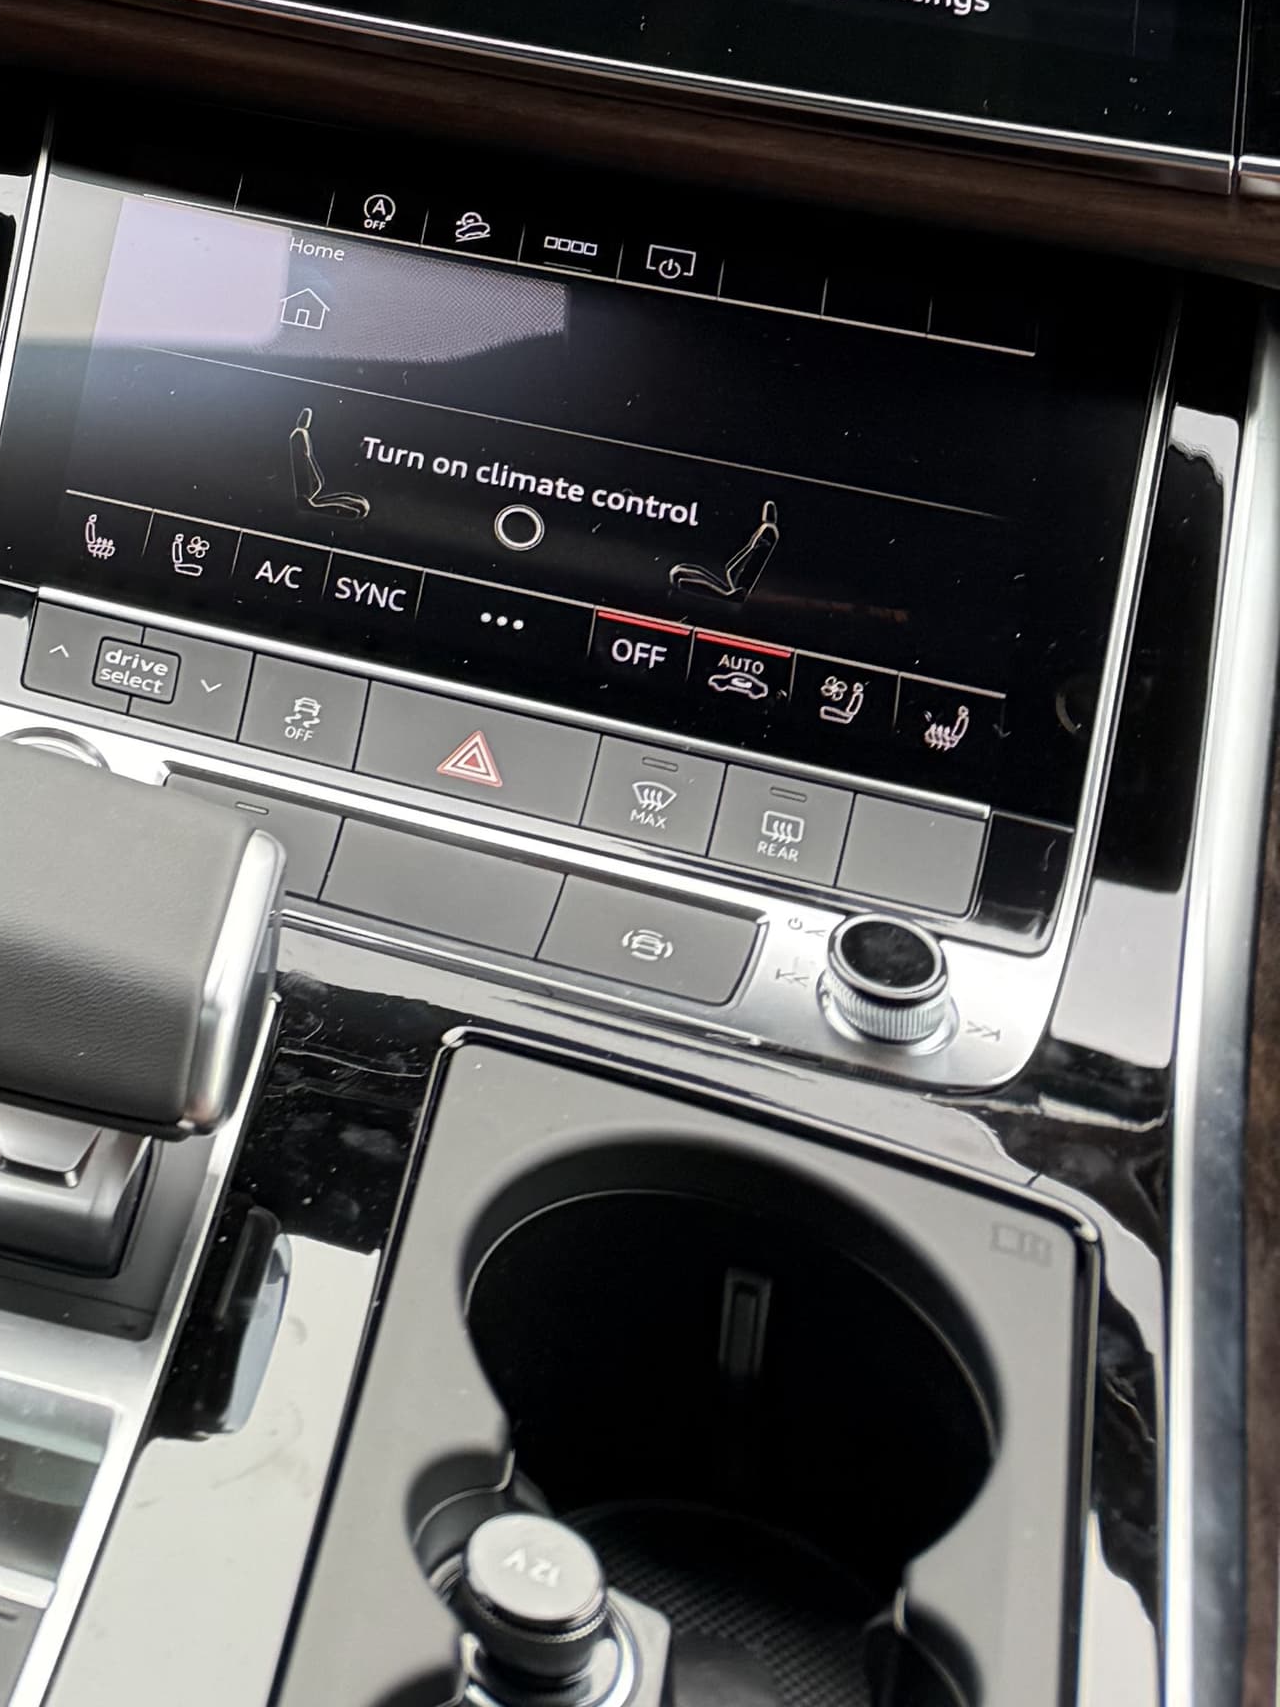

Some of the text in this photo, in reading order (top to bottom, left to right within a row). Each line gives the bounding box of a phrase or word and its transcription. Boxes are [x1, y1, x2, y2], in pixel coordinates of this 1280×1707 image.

[364, 218, 386, 231] OFF
[289, 237, 345, 262] Home
[363, 436, 699, 526] Turn on climate control
[255, 561, 764, 676] A/C SYNC OFF AUTO
[104, 648, 168, 676] drive
[100, 667, 164, 695] select
[284, 724, 315, 742] OFF
[631, 808, 668, 829] MAX
[757, 841, 799, 863] REAR
